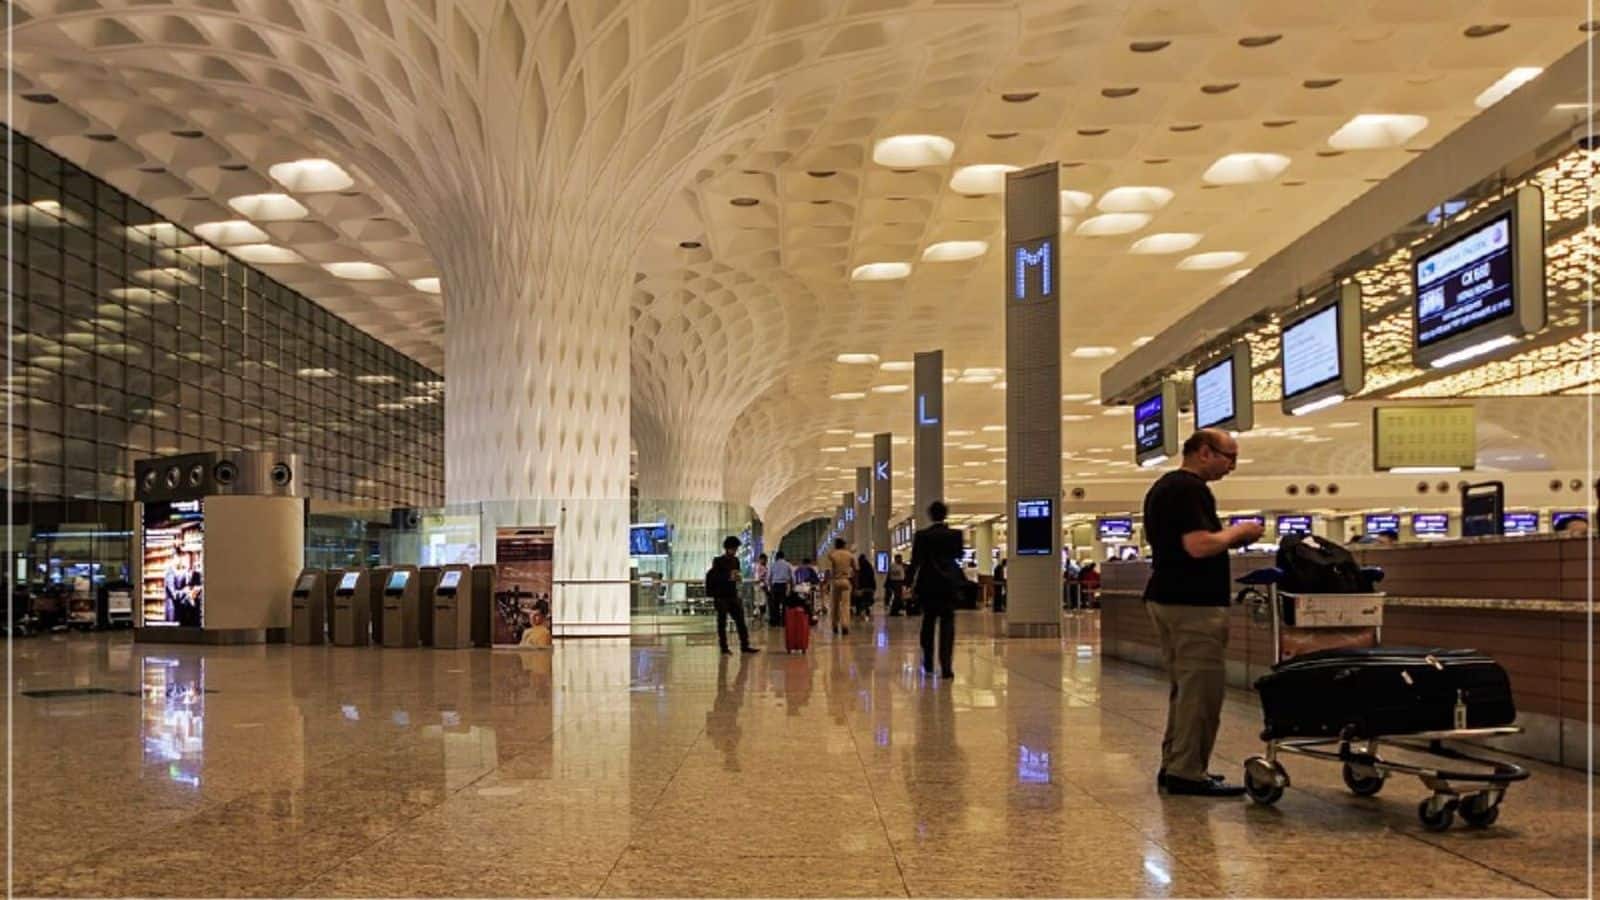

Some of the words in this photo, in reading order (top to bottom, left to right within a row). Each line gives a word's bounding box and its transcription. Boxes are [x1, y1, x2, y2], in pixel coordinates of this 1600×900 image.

[1015, 242, 1051, 298] M
[919, 395, 938, 425] L
[877, 462, 889, 480] K
[858, 487, 870, 504] J
[845, 508, 854, 521] H
